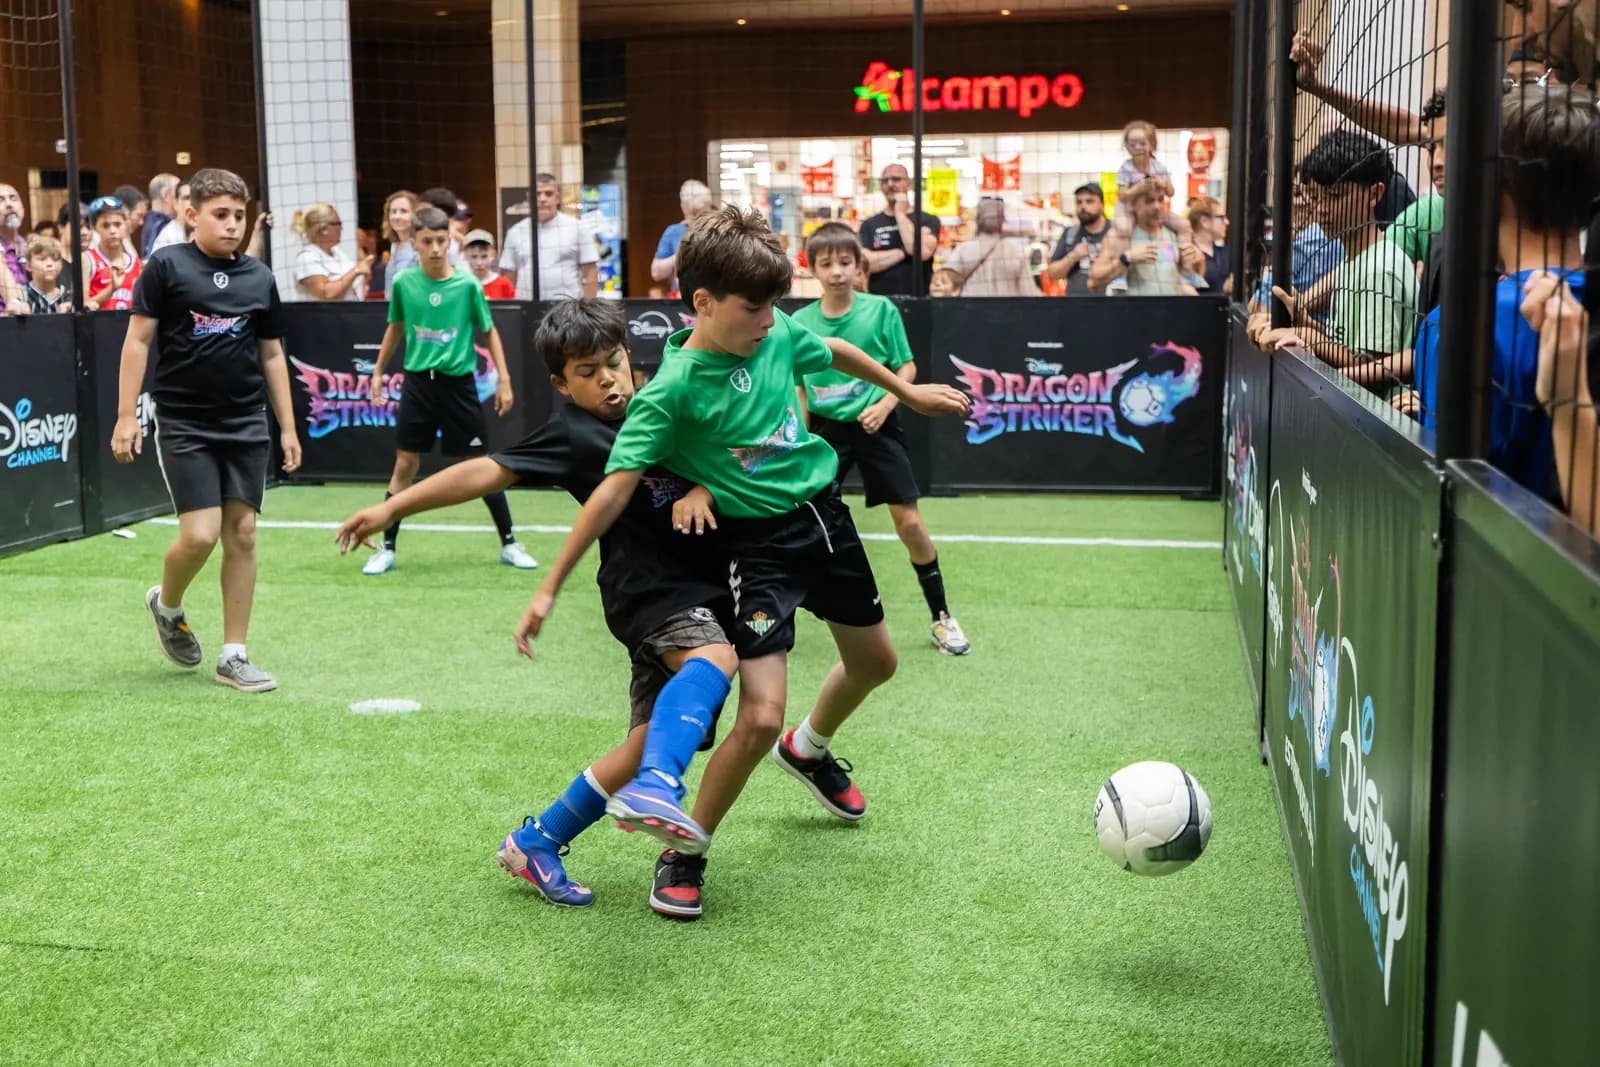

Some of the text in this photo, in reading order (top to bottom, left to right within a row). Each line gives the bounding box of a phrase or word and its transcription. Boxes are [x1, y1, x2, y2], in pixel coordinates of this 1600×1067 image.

[854, 61, 1084, 117] Alcampo
[949, 353, 1139, 403] DRAGON
[306, 400, 400, 438] STRIK
[964, 402, 1145, 453] STRIKER
[7, 445, 61, 468] CHANNEL
